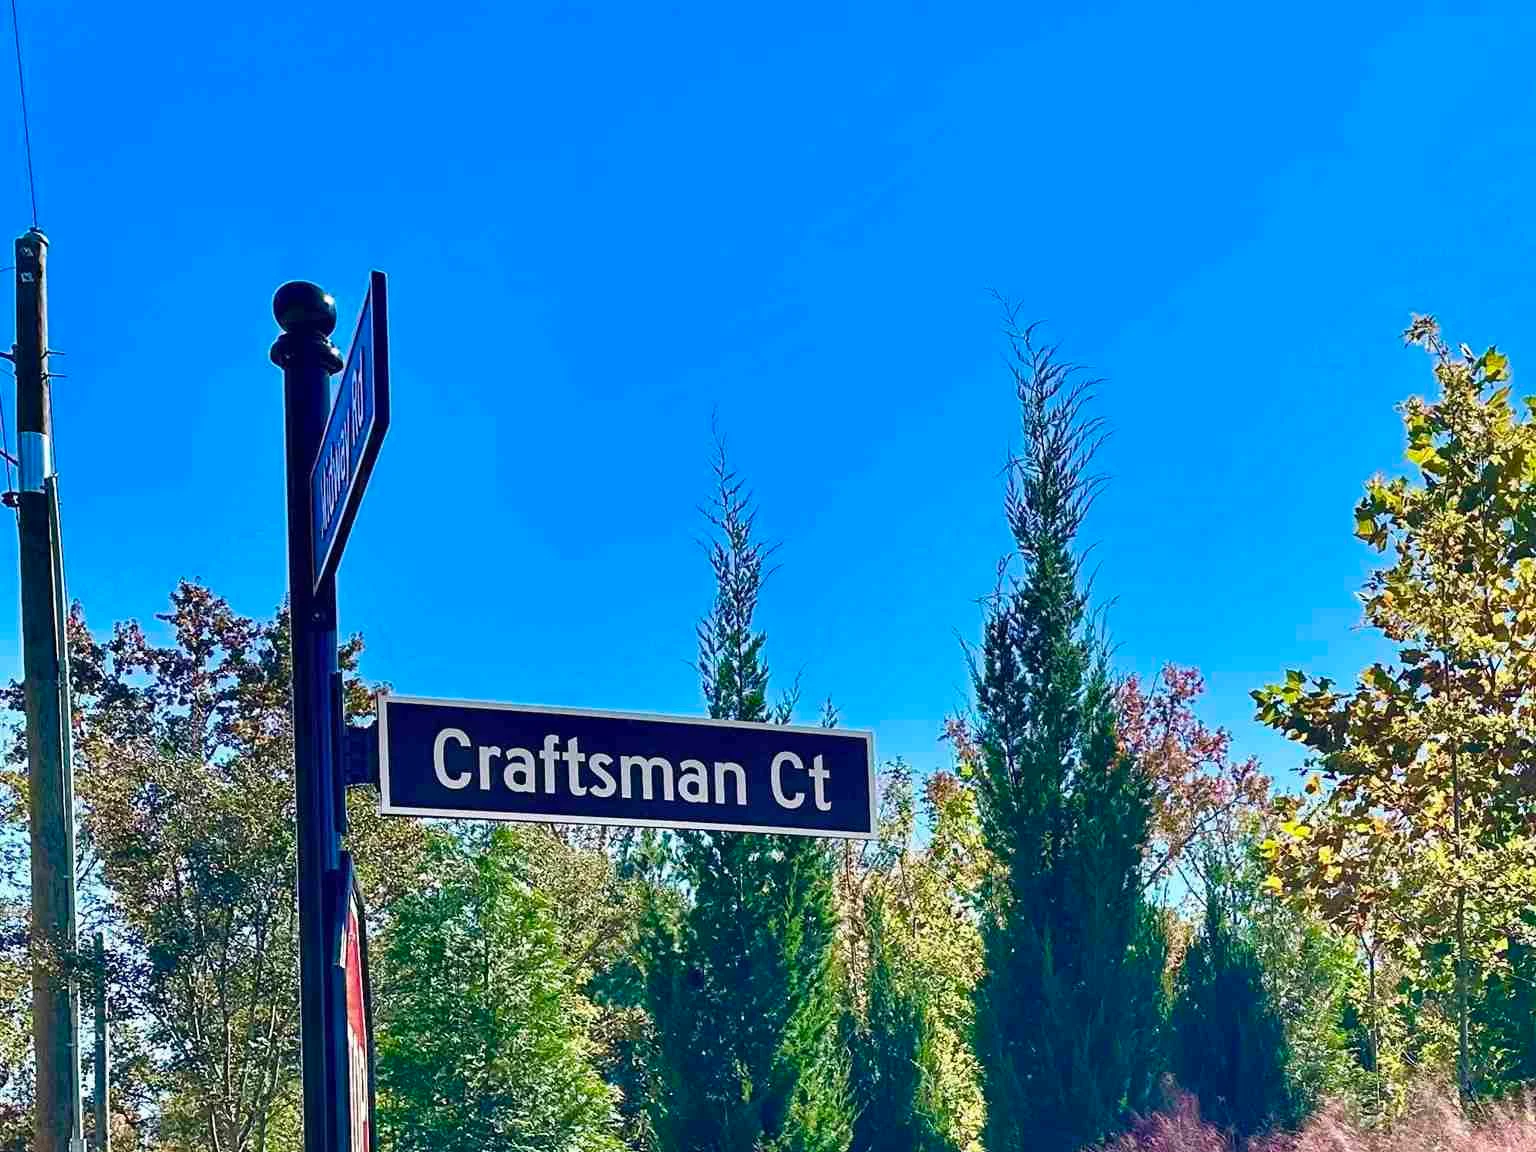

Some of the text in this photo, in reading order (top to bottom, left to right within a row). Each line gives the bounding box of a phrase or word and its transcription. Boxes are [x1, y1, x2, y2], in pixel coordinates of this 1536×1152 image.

[351, 346, 364, 447] Rd
[432, 727, 833, 812] Craftsman Ct
